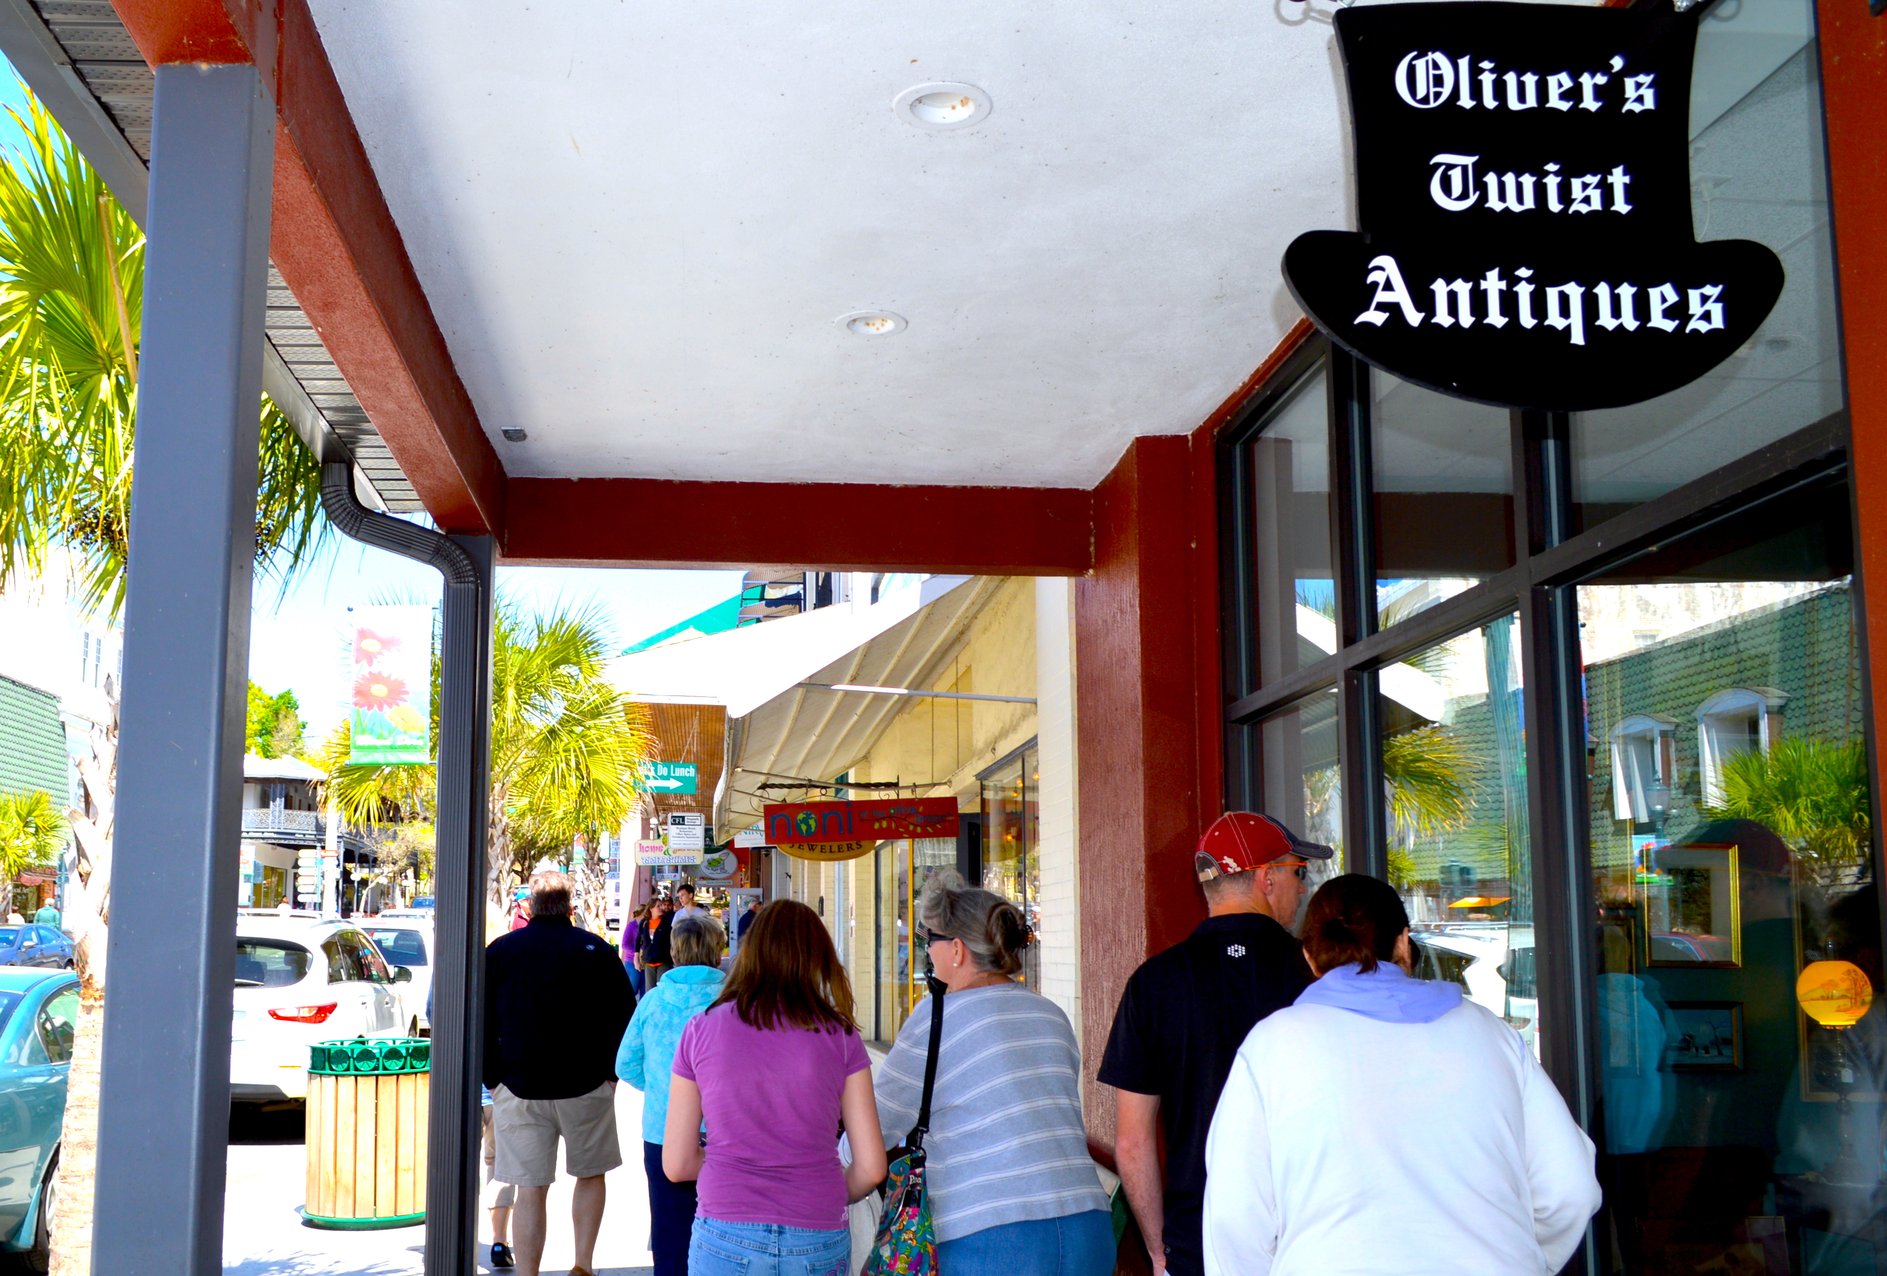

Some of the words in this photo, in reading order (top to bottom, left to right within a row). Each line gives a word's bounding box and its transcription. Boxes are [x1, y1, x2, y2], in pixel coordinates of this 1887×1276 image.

[1395, 51, 1658, 114] Oliver's
[1430, 153, 1634, 215] Twist
[1354, 255, 1728, 346] Antiques
[657, 764, 668, 776] Do
[670, 764, 695, 777] Lunch
